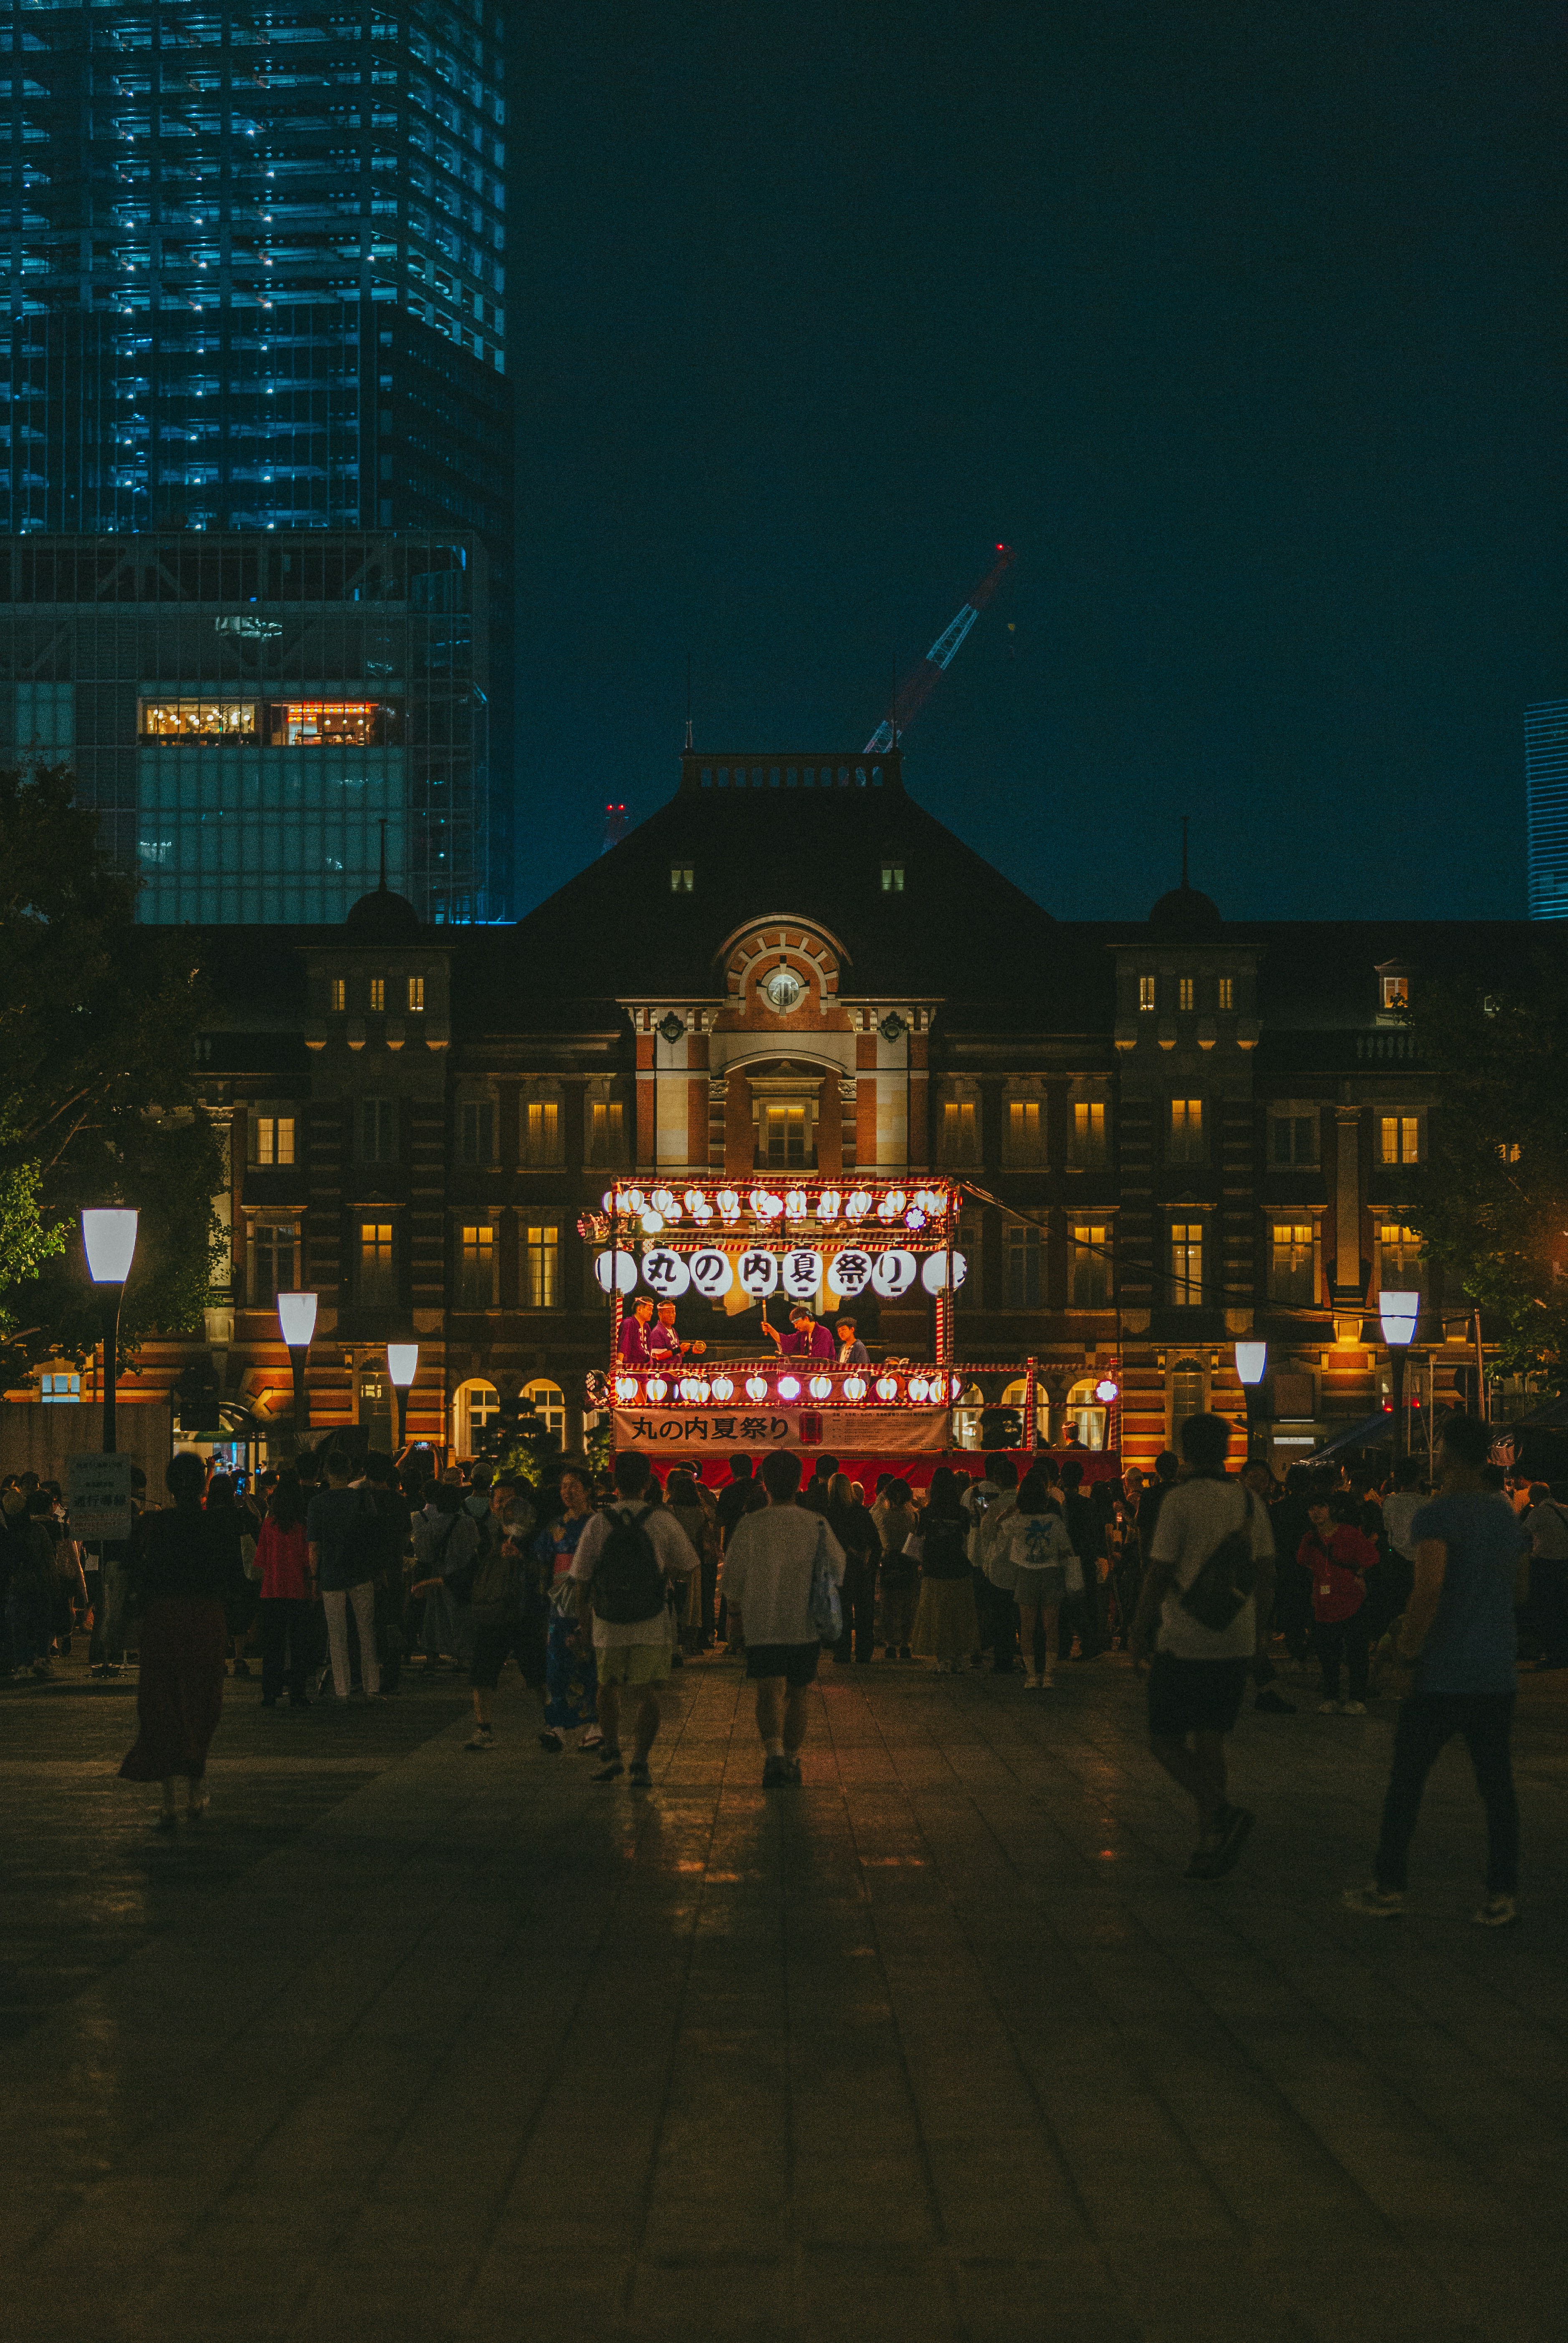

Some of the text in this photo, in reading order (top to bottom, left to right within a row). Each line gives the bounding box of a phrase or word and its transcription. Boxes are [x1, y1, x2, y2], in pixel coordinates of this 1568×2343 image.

[647, 1252, 902, 1284] 丸の内夏祭り
[632, 1416, 789, 1440] 丸の内夏祭り
